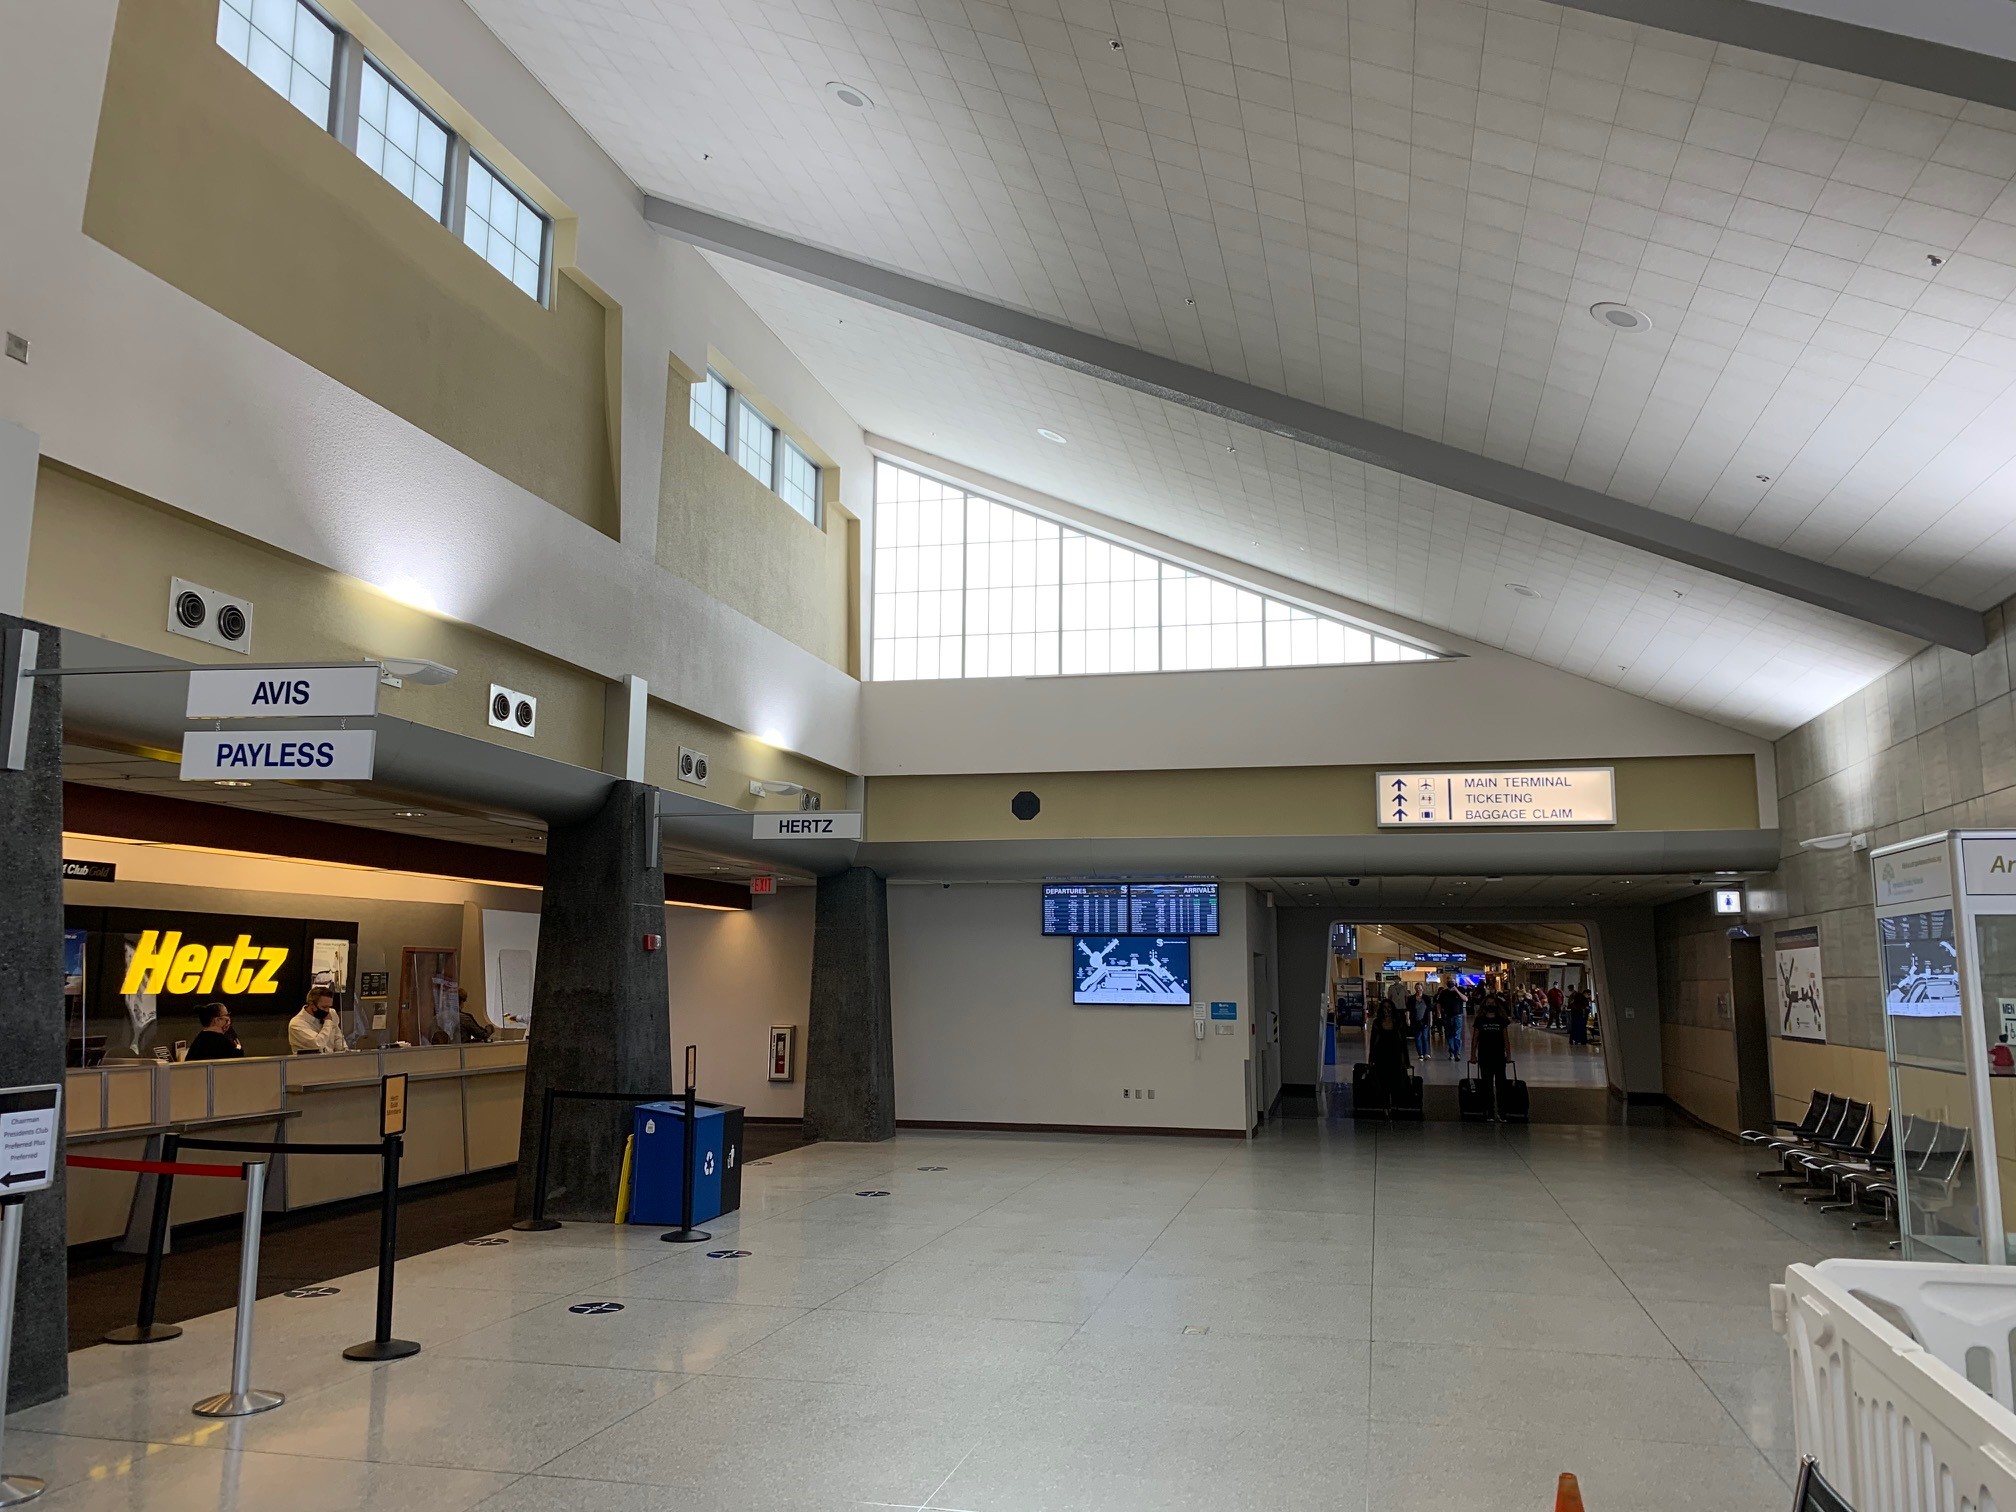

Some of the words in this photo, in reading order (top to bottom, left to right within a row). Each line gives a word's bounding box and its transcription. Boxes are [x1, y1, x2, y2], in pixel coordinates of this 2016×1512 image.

[251, 680, 310, 705] AVIS
[216, 742, 334, 768] PAYLESS
[1464, 777, 1498, 788] MAIN
[1503, 776, 1572, 788] TERMINAL
[1465, 793, 1533, 804] TICKETING
[1465, 809, 1526, 820] BAGGAGE
[1532, 809, 1573, 819] CLAIM
[778, 819, 833, 834] HERTZ
[67, 864, 89, 876] Club
[89, 866, 110, 877] Gold
[754, 877, 772, 893] EXIT
[119, 929, 289, 995] Hertz
[2002, 1003, 2015, 1015] MEN
[10, 1117, 40, 1126] Chairman
[3, 1128, 35, 1138] Presidents
[35, 1127, 49, 1135] Club
[4, 1141, 33, 1150] Preferred
[10, 1152, 38, 1162] Preferred
